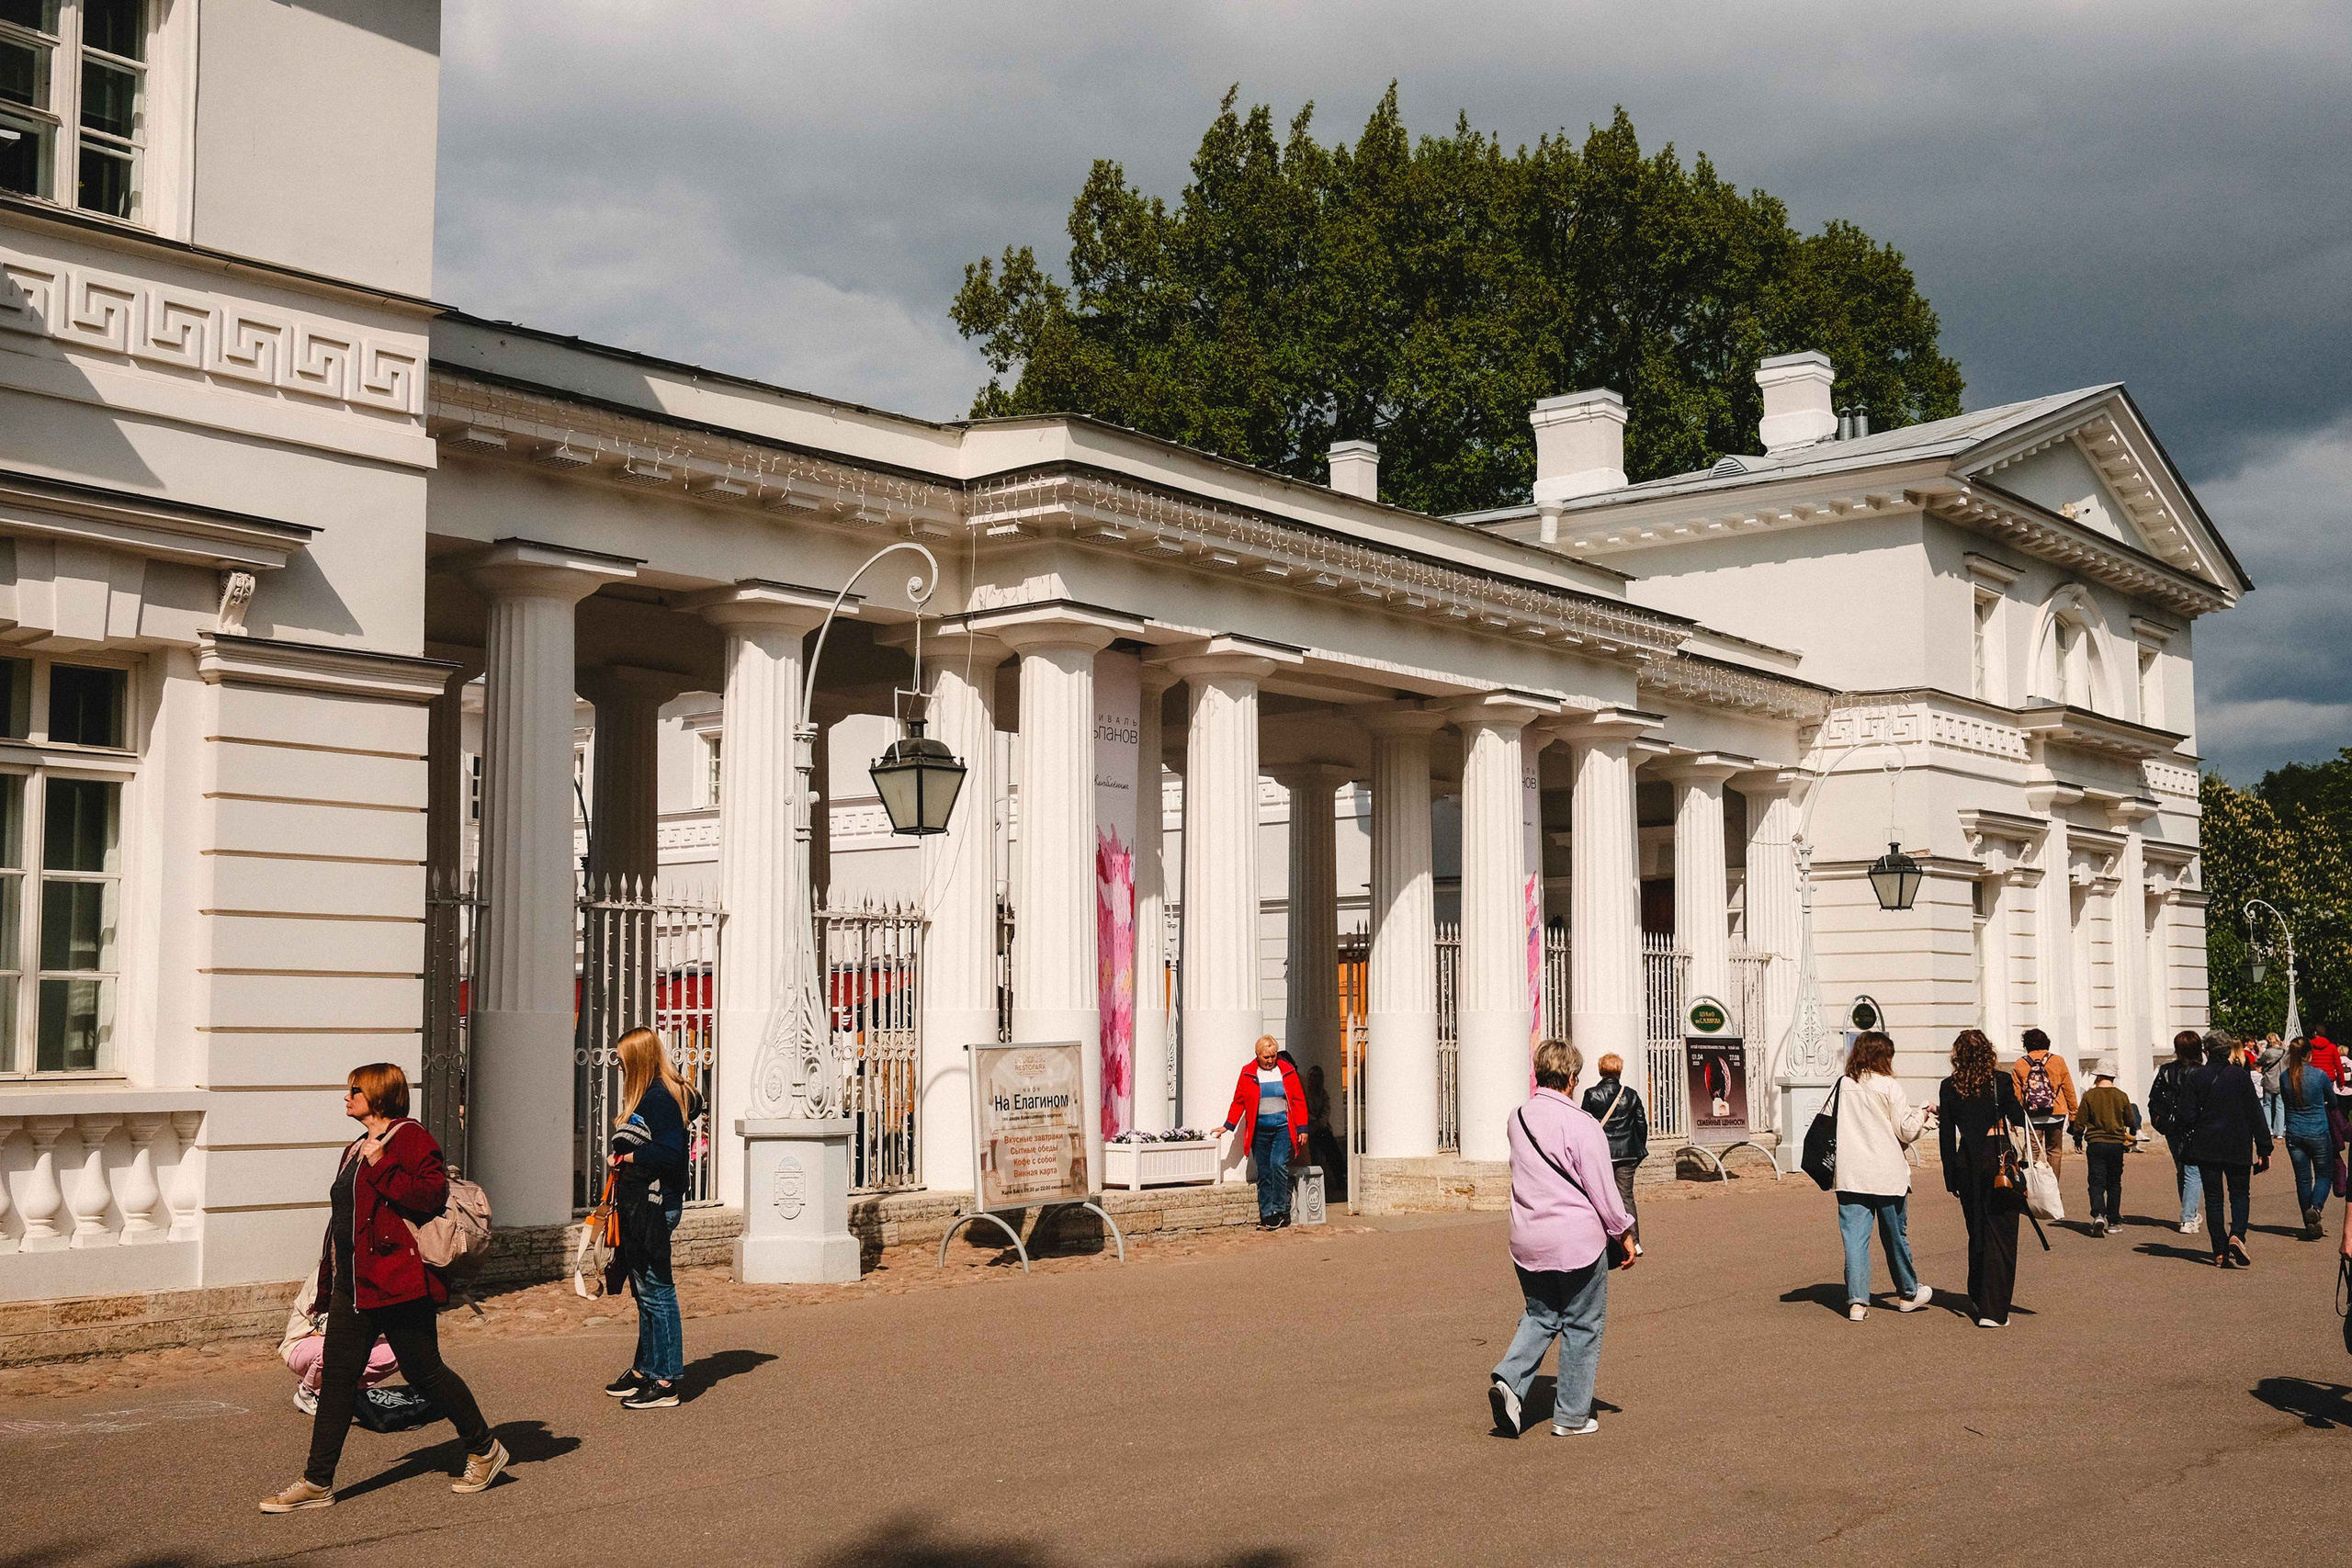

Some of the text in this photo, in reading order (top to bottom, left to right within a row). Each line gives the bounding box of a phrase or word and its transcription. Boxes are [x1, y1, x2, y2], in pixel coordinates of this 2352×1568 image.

[994, 1093, 1069, 1111] На Елагином
[1004, 1133, 1064, 1145] Вкусные завтраки
[1010, 1145, 1058, 1155] Сытные обеды
[1013, 1157, 1031, 1167] Кофе
[1037, 1156, 1057, 1164] собой
[1013, 1168, 1057, 1178] Винная карта
